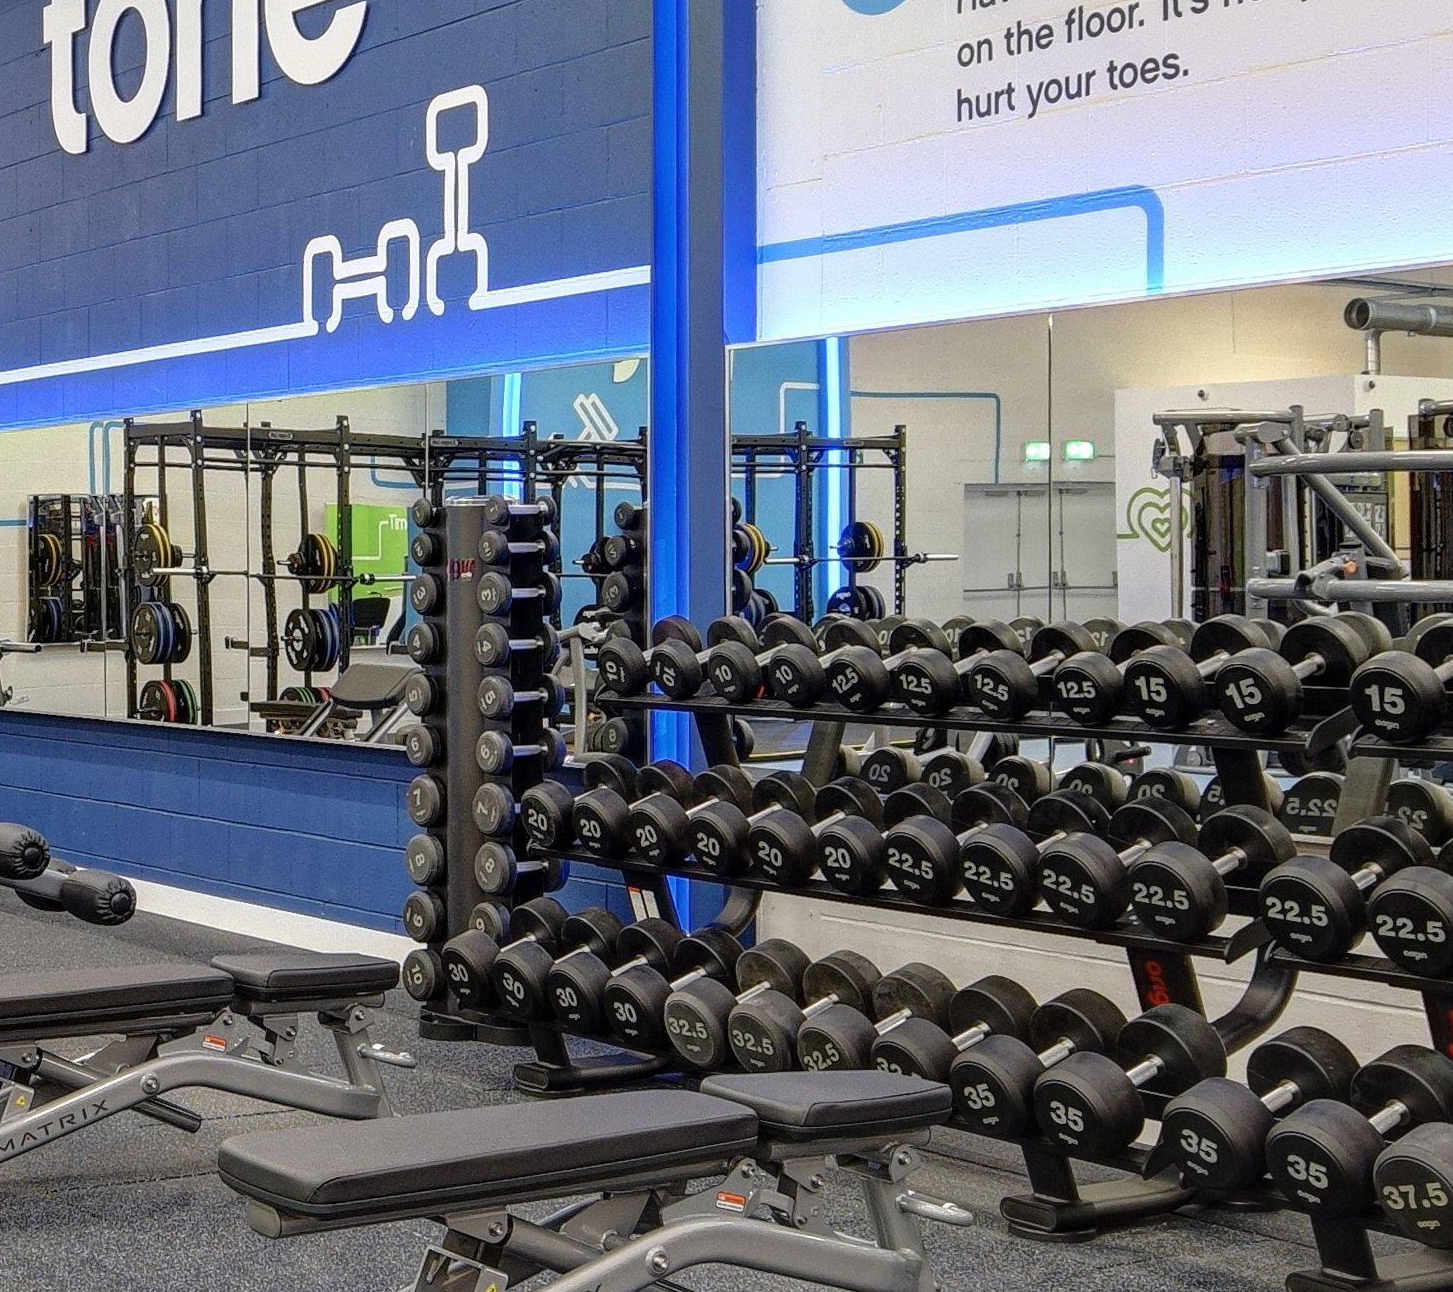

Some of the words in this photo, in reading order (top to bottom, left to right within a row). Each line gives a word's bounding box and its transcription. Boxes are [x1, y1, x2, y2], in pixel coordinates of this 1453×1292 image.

[957, 25, 993, 67] on
[1005, 21, 1054, 57] the
[1065, 1, 1146, 43] floor.
[957, 81, 1016, 122] hurt
[1027, 68, 1097, 119] your
[1107, 52, 1190, 91] toes.
[832, 667, 858, 693] 12.5
[900, 674, 931, 694] 12.5
[975, 674, 1008, 701] 12.5
[1057, 681, 1095, 698] 12.5
[1135, 676, 1167, 702] 15
[1225, 678, 1261, 708] 15
[1365, 684, 1405, 714] 15
[413, 789, 422, 805] 7
[758, 841, 782, 867] 20
[825, 847, 851, 868] 20
[888, 848, 933, 879] 22.5
[964, 861, 1013, 890] 22.5
[1043, 869, 1095, 903] 22.5
[1132, 882, 1190, 911] 22.5
[1266, 897, 1328, 926] 22.5
[1376, 915, 1445, 942] 22.5
[503, 972, 524, 999] 30
[669, 1017, 708, 1039] 32.5
[732, 1029, 774, 1056] 32.5
[964, 1084, 995, 1109] 35
[1050, 1101, 1083, 1131] 35
[1181, 1129, 1217, 1163] 35
[1287, 1155, 1328, 1188] 35
[1383, 1182, 1448, 1209] 37.5
